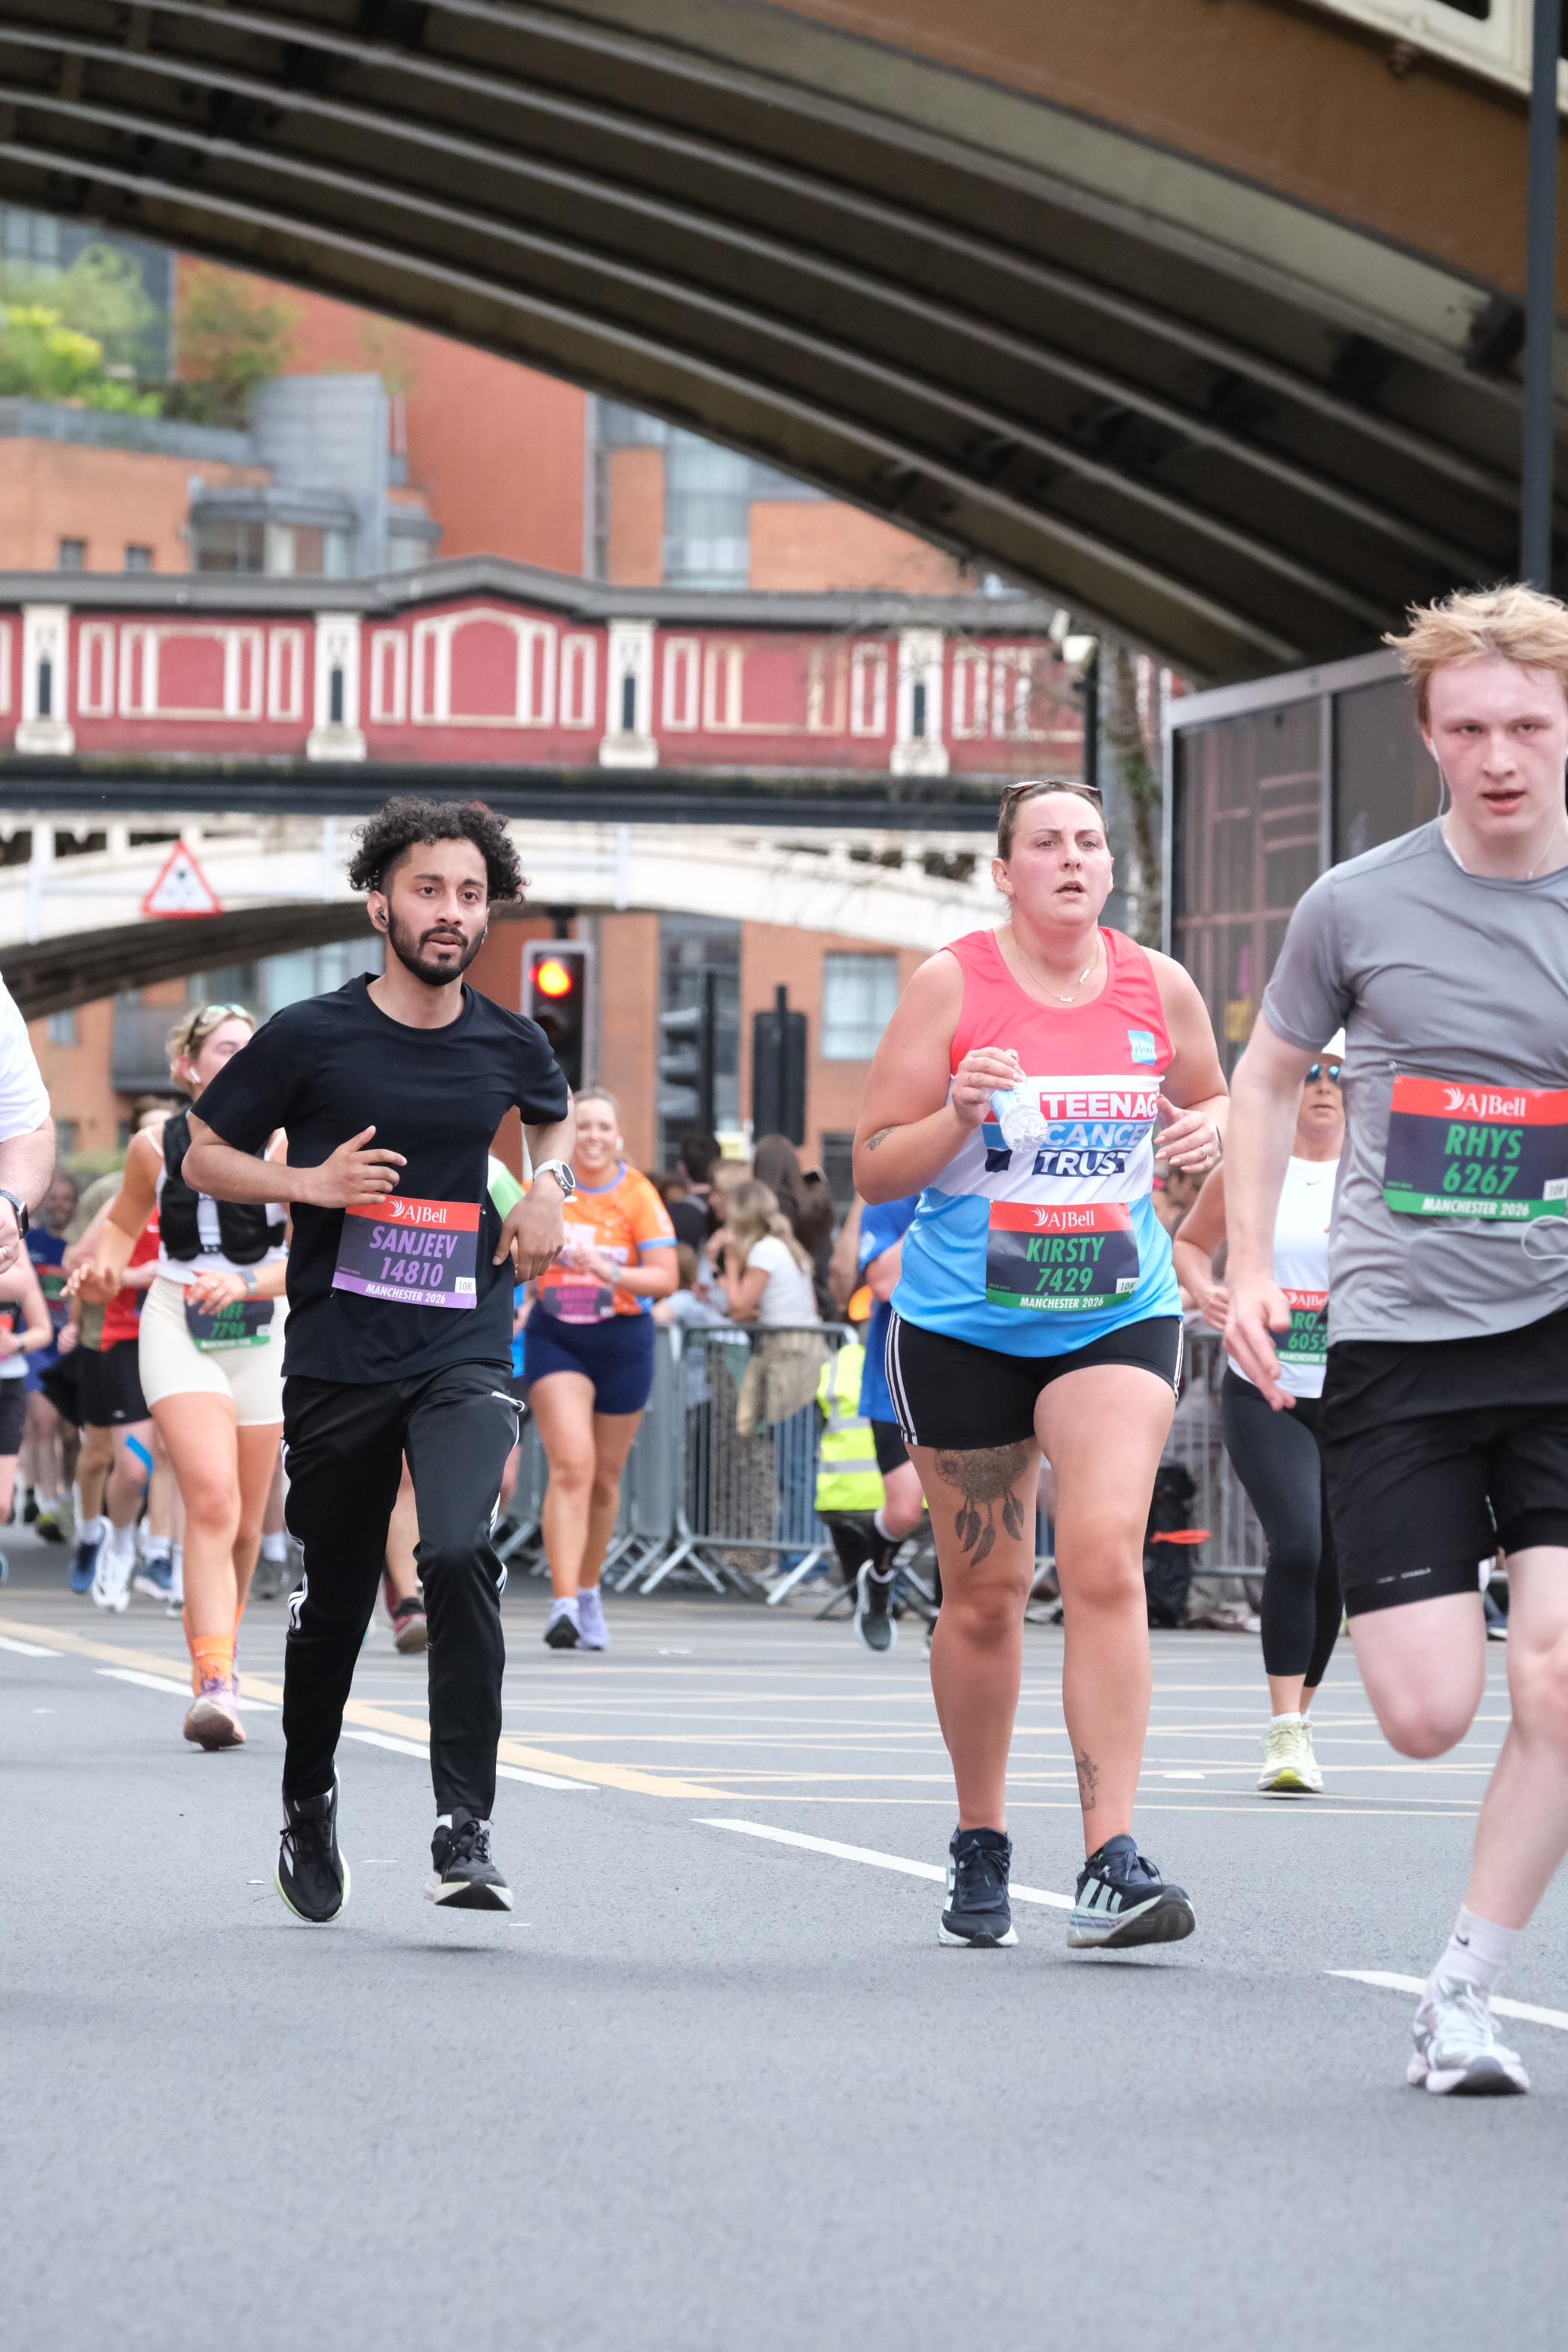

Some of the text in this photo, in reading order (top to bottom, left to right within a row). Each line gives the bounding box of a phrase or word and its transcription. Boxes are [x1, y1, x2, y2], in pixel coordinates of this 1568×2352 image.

[1042, 1093, 1159, 1118] TEENAG
[1463, 1093, 1526, 1118] AJBell
[1043, 1122, 1153, 1147] CANCE
[1444, 1123, 1524, 1160] RHYS
[1442, 1162, 1520, 1196] 6267
[403, 1205, 447, 1224] AJBell
[1422, 1197, 1530, 1217] MANCHESTER 2026
[1048, 1210, 1095, 1231] AJBell
[369, 1225, 458, 1259] SANJEEV
[1025, 1236, 1106, 1263] KIRSTY
[380, 1256, 444, 1288] 14810
[1034, 1267, 1094, 1293] 7429
[365, 1283, 446, 1304] MANCHESTER 2026
[458, 1280, 473, 1292] 10K
[1120, 1281, 1135, 1291] 10K
[1020, 1296, 1104, 1309] MANCHESTER 2026
